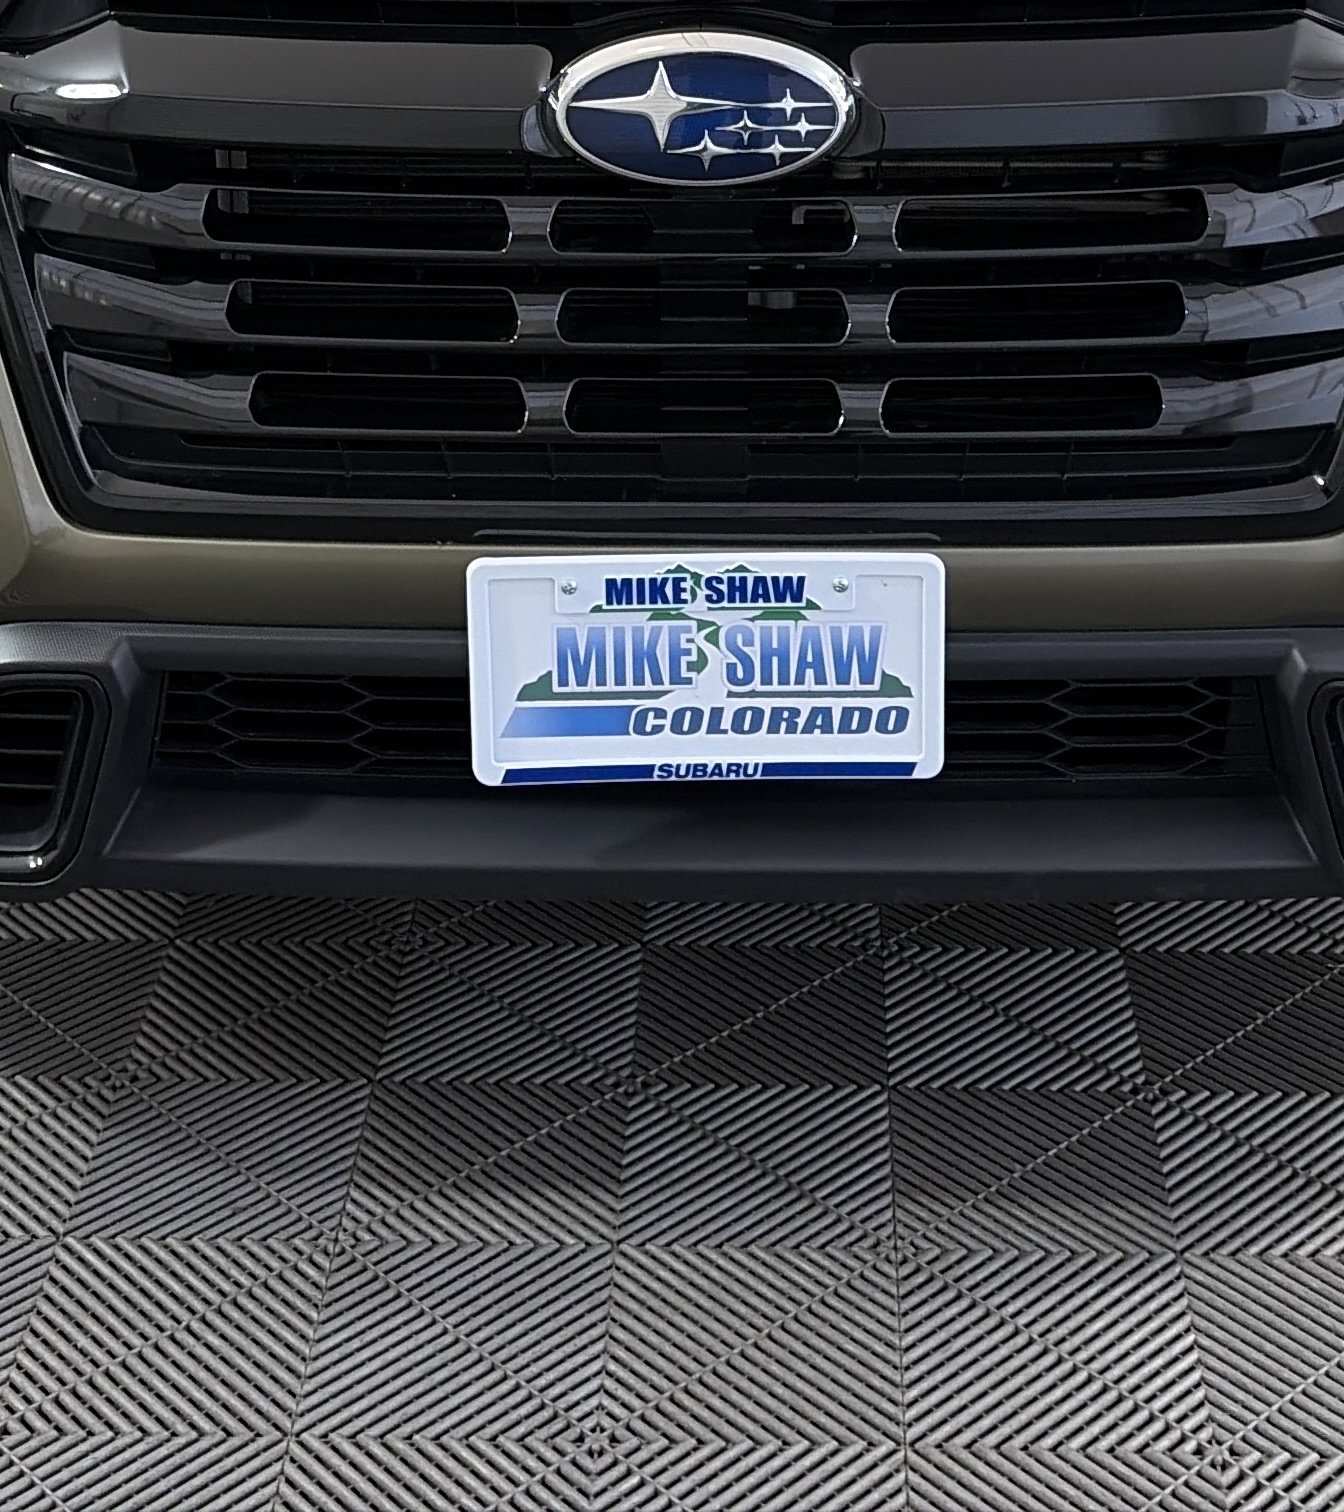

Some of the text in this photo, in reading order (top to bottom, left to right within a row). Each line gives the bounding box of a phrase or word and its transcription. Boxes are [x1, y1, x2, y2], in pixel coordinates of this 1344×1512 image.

[604, 575, 806, 605] MIKE SHAW
[555, 624, 883, 688] MIKE SHAW
[631, 705, 910, 735] COLORADO
[657, 762, 759, 779] SUBARU
